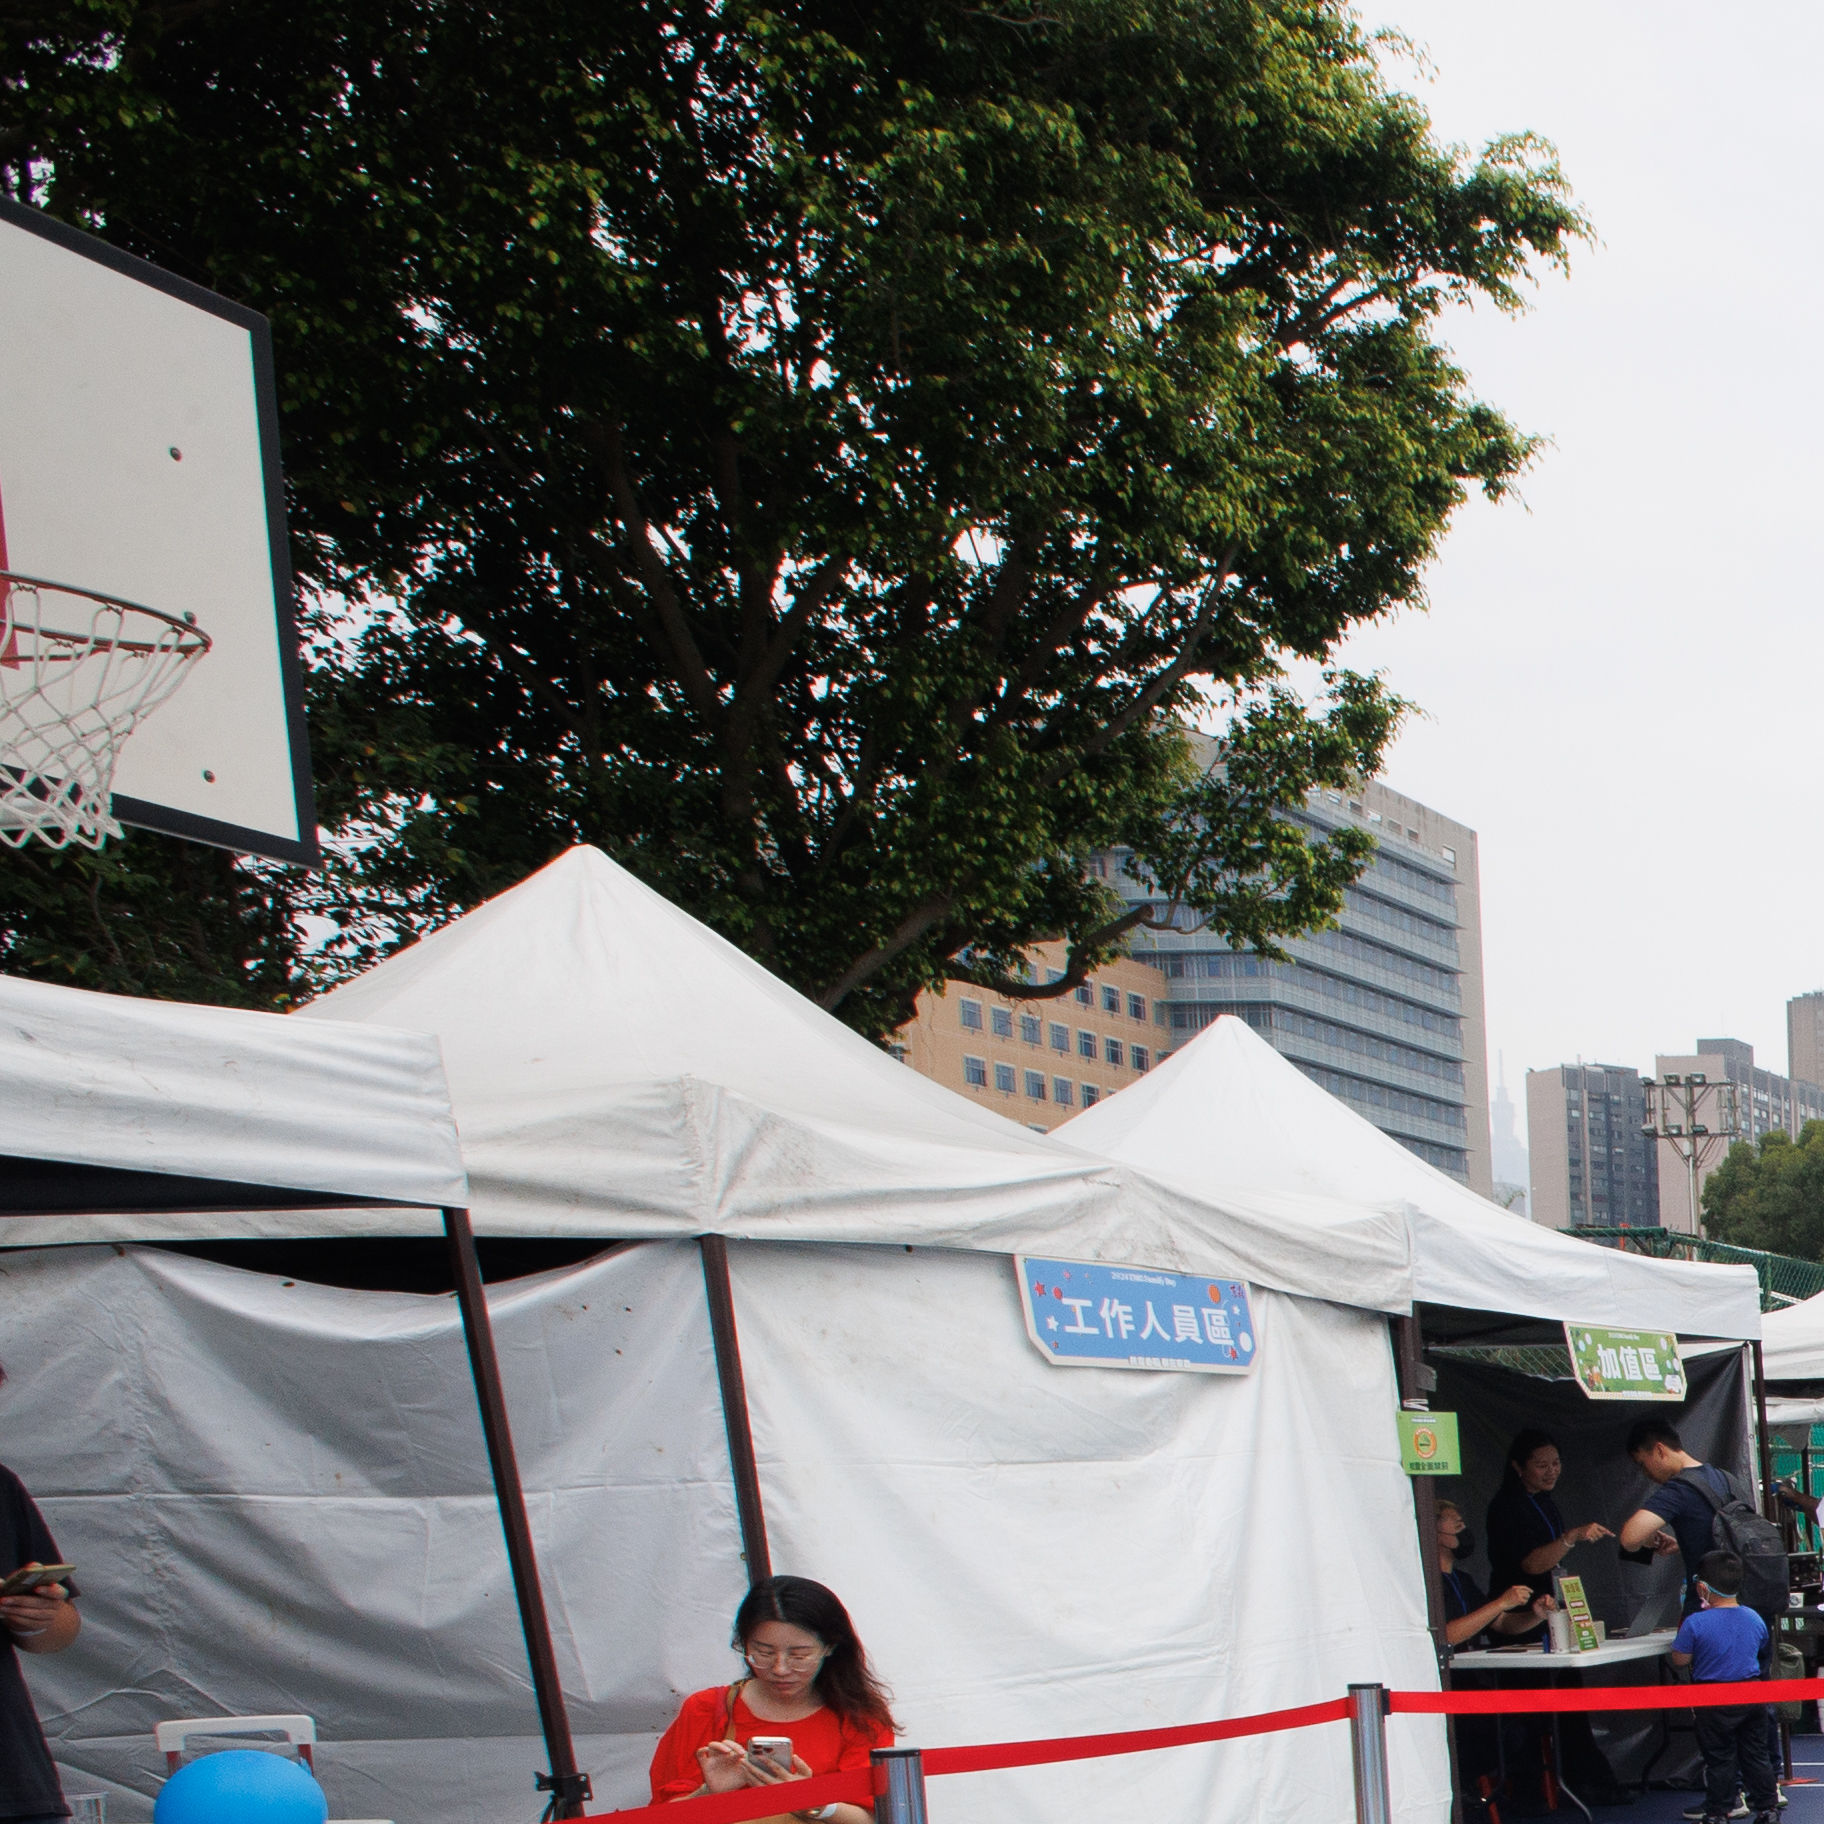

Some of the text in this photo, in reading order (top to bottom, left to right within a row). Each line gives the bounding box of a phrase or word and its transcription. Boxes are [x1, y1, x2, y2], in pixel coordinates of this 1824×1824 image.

[1061, 1297, 1235, 1347] 工作人員區
[1597, 1343, 1663, 1380] 加值區
